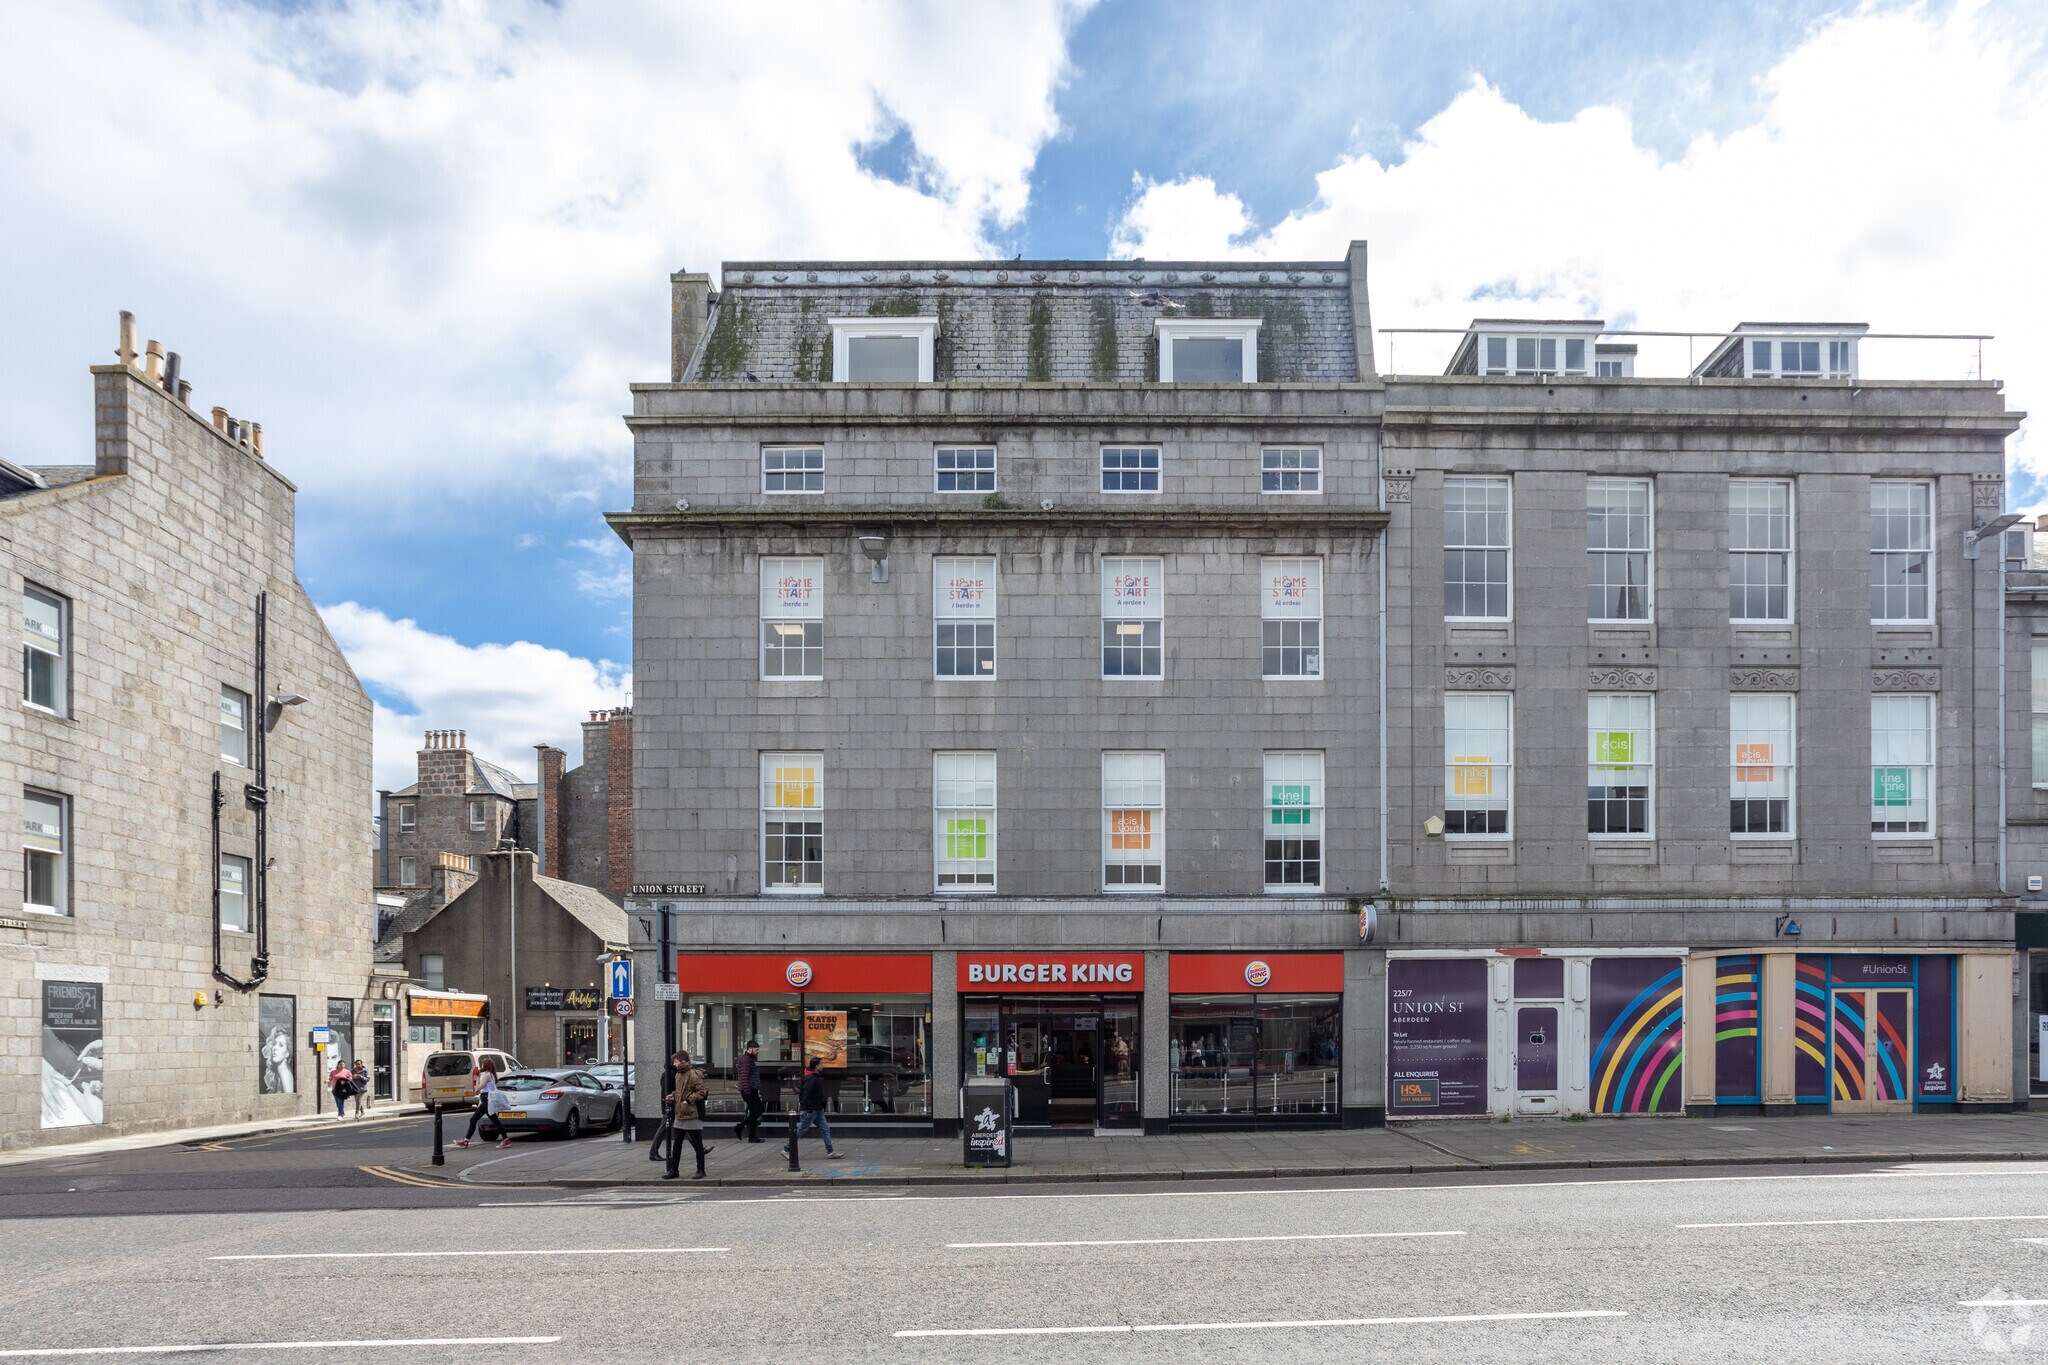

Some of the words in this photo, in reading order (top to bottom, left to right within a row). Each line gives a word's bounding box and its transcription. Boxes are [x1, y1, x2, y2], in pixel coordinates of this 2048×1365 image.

[1272, 576, 1306, 588] HOME
[1602, 738, 1628, 750] acis
[1278, 792, 1300, 800] one
[632, 885, 662, 893] UNION
[666, 885, 704, 894] STREET
[968, 964, 1067, 982] BURGER
[1072, 964, 1133, 982] KING
[1862, 964, 1907, 974] #UnionSt
[1250, 971, 1267, 980] KING
[48, 985, 84, 999] FRIENDS
[84, 992, 97, 1009] 21
[1393, 1002, 1444, 1013] UNION
[808, 1023, 837, 1032] CURRY
[1401, 1085, 1422, 1095] HSA
[970, 1138, 1004, 1147] inspired
